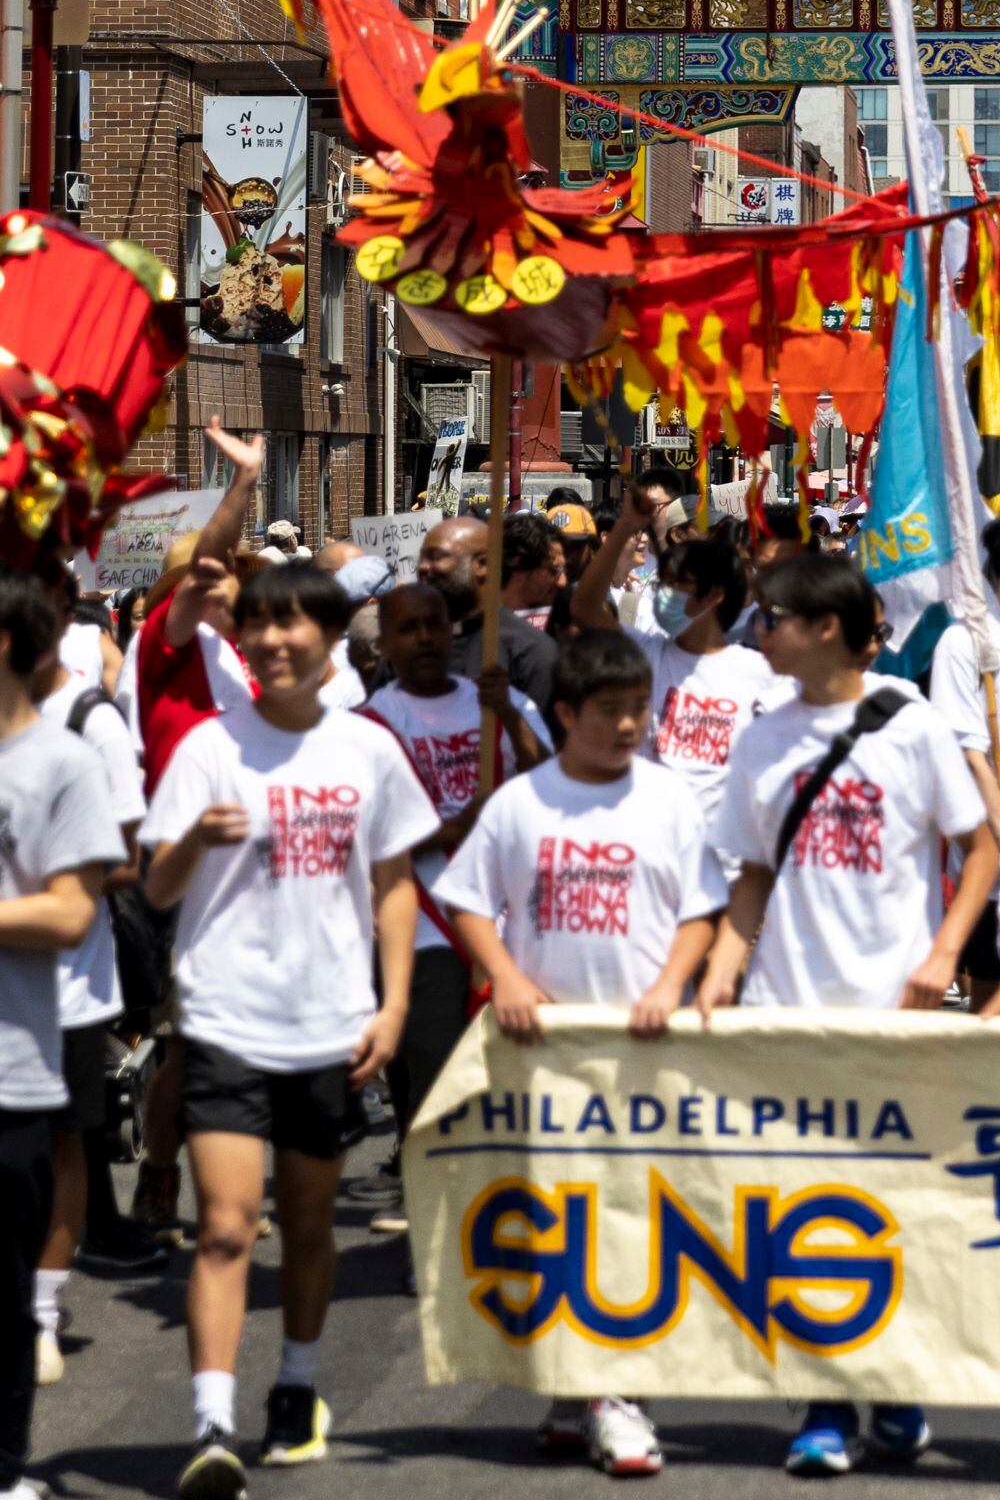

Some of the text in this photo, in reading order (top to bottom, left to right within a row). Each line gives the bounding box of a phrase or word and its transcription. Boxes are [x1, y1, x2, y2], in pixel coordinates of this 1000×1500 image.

[774, 184, 796, 224] 棋牌
[431, 457, 462, 472] OER
[127, 540, 164, 552] ARENA
[356, 522, 428, 547] NO ARENA
[98, 567, 166, 588] SAVE CHIN
[684, 693, 738, 714] NO
[673, 724, 729, 746] CHINA
[672, 741, 728, 766] TOWN
[291, 785, 360, 807] NO
[562, 837, 636, 865] NO
[811, 844, 882, 874] TOWN
[555, 882, 629, 909] CHINA
[556, 907, 629, 936] TOWN
[437, 1092, 914, 1141] PHILADELPHIA
[460, 1163, 904, 1368] SUNS
